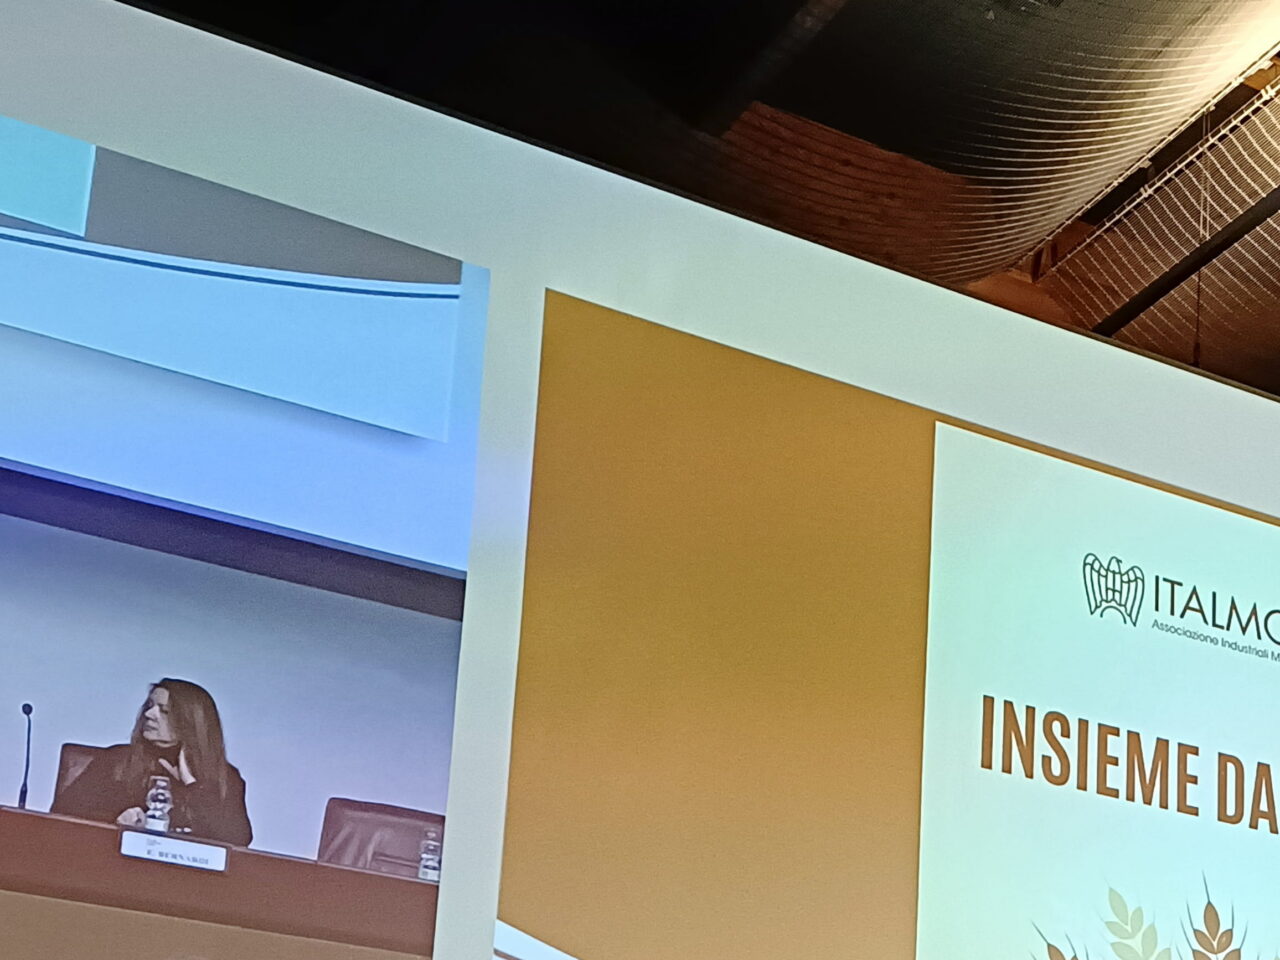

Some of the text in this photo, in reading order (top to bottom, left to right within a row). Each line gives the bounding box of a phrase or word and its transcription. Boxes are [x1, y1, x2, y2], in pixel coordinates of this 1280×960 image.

[1151, 618, 1219, 646] Associazione
[1220, 637, 1269, 660] Industriali
[980, 694, 1200, 817] INSIEME
